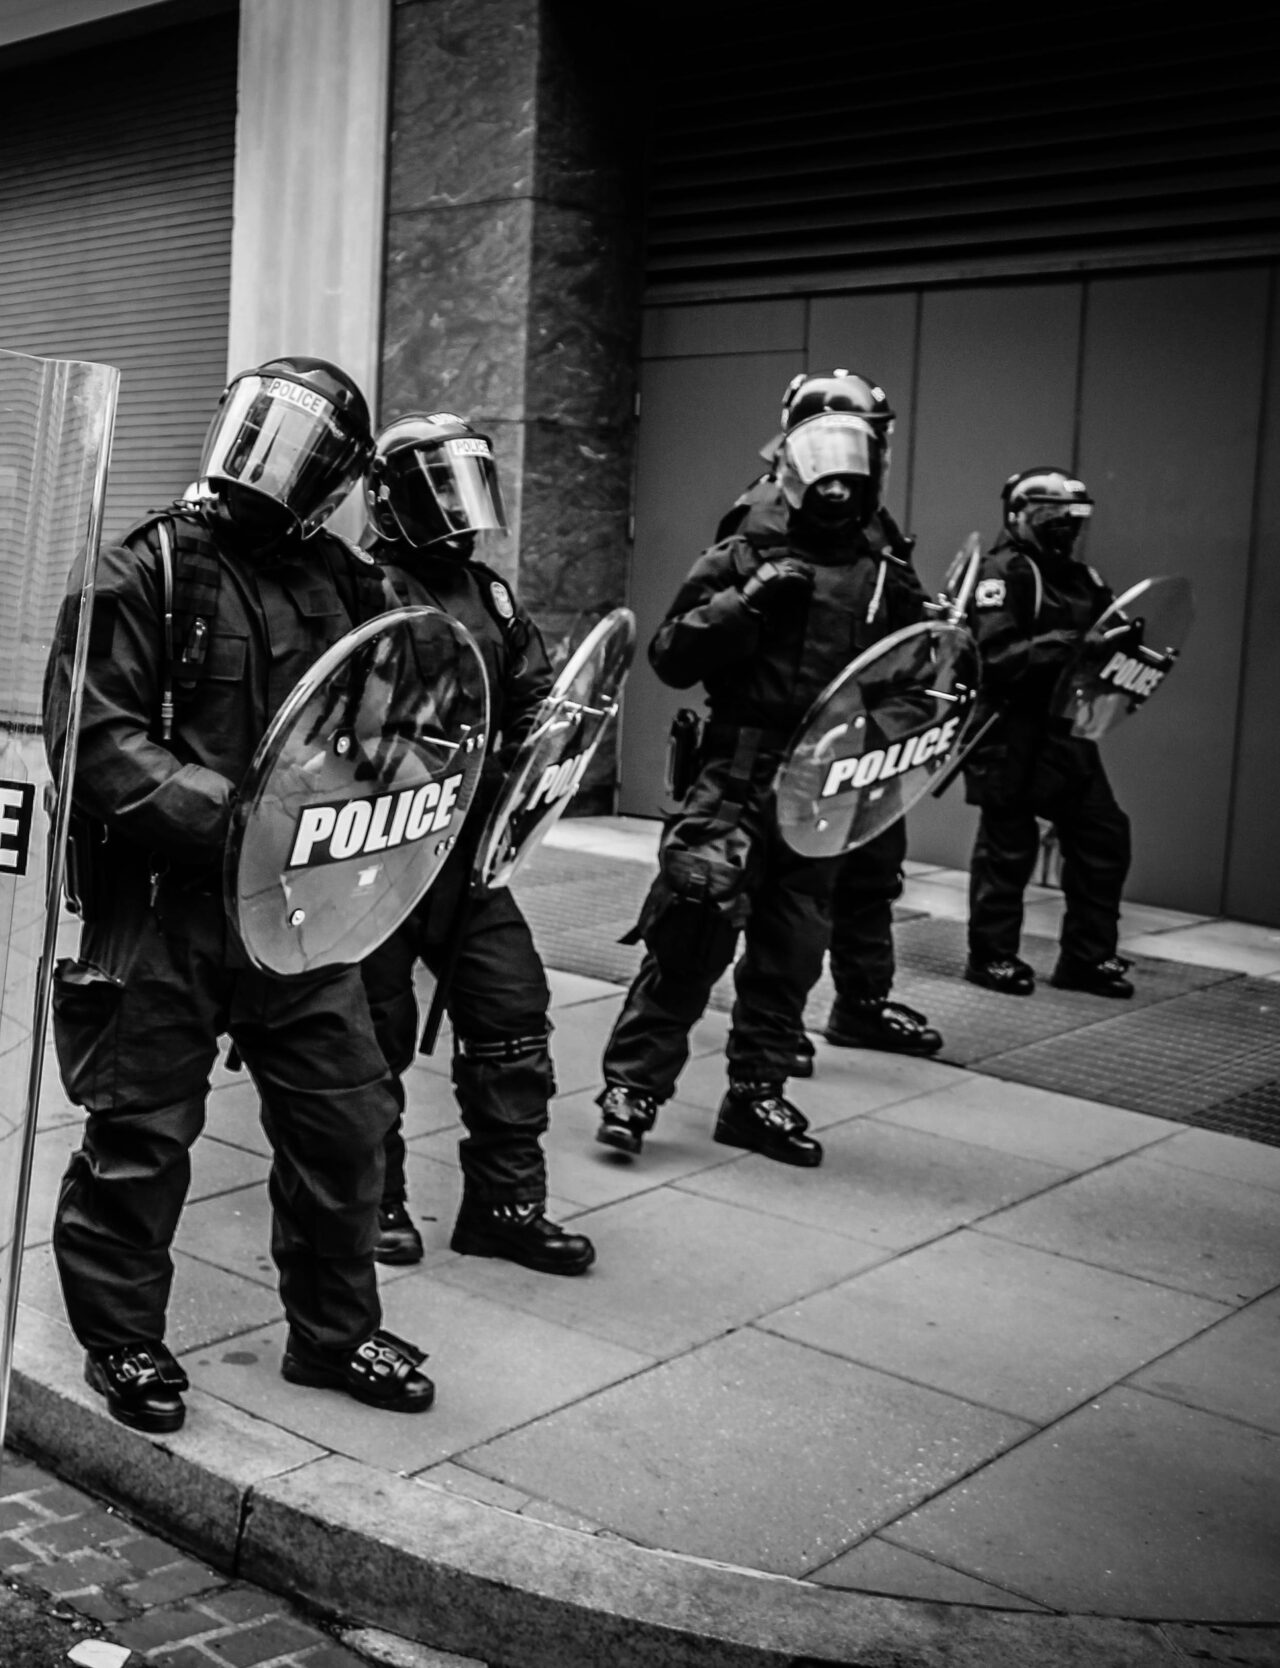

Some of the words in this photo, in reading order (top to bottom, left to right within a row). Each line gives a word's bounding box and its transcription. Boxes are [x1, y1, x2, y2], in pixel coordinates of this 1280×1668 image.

[270, 381, 322, 413] POLICE
[822, 716, 959, 797] POLICE
[290, 774, 463, 867] POLICE
